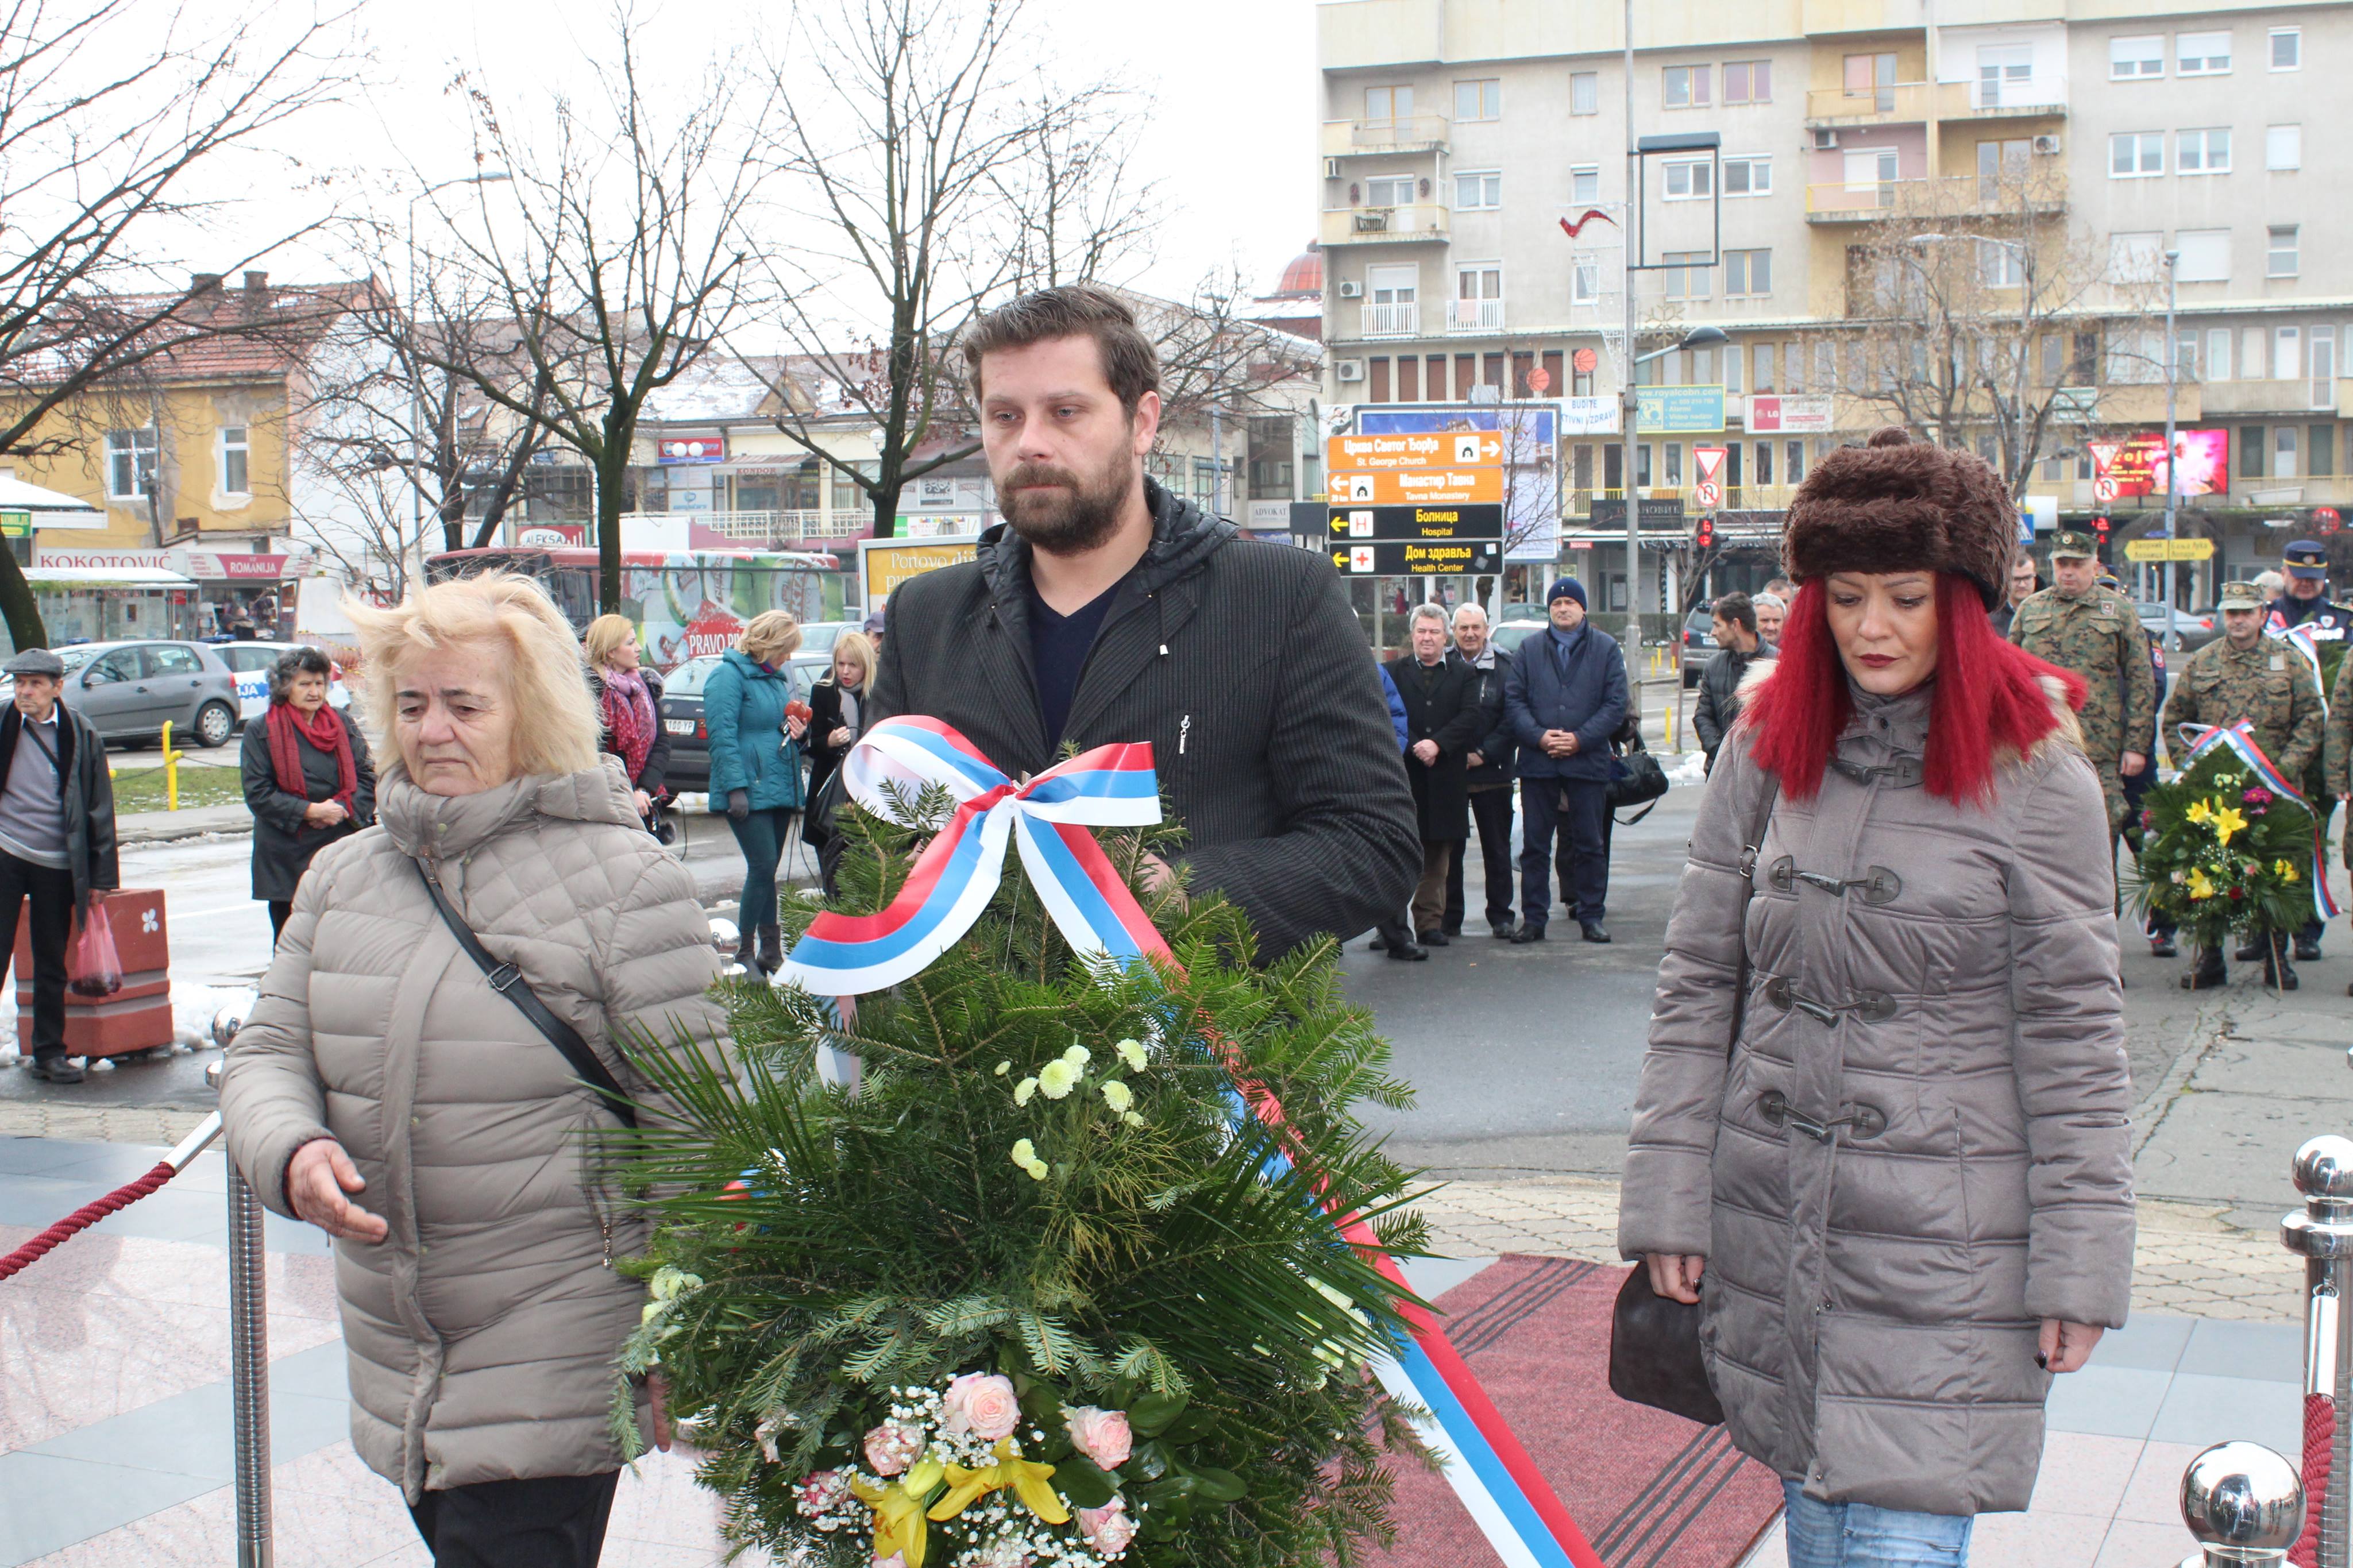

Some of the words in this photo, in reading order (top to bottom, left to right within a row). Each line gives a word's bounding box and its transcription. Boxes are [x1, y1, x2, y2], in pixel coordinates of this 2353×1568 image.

[1572, 399, 1598, 409] BUDITE
[1590, 409, 1615, 424] ZDRAVI
[1344, 439, 1372, 456] Црква
[1374, 438, 1406, 453] Светог
[1408, 437, 1439, 454] Ђорђа
[1357, 457, 1367, 466] St.
[1369, 457, 1397, 467] George
[1399, 457, 1426, 465] Church
[1399, 473, 1445, 489] Манастир
[1446, 472, 1475, 486] Тавна
[1405, 492, 1428, 500] Tavna
[1429, 491, 1470, 501] Monastery
[1416, 509, 1458, 523] Болница
[1356, 517, 1367, 531] H
[526, 534, 563, 543] ALEKSA
[1422, 527, 1453, 537] Hospital
[1405, 545, 1426, 561] Дом
[1428, 547, 1471, 561] здравља
[40, 551, 173, 571] KOKOTOVIĆ
[230, 562, 276, 573] ROMANIJA
[892, 553, 948, 569] Ponovo
[1411, 564, 1436, 572] Health
[1438, 563, 1464, 572] Center
[689, 634, 725, 655] PRAVO
